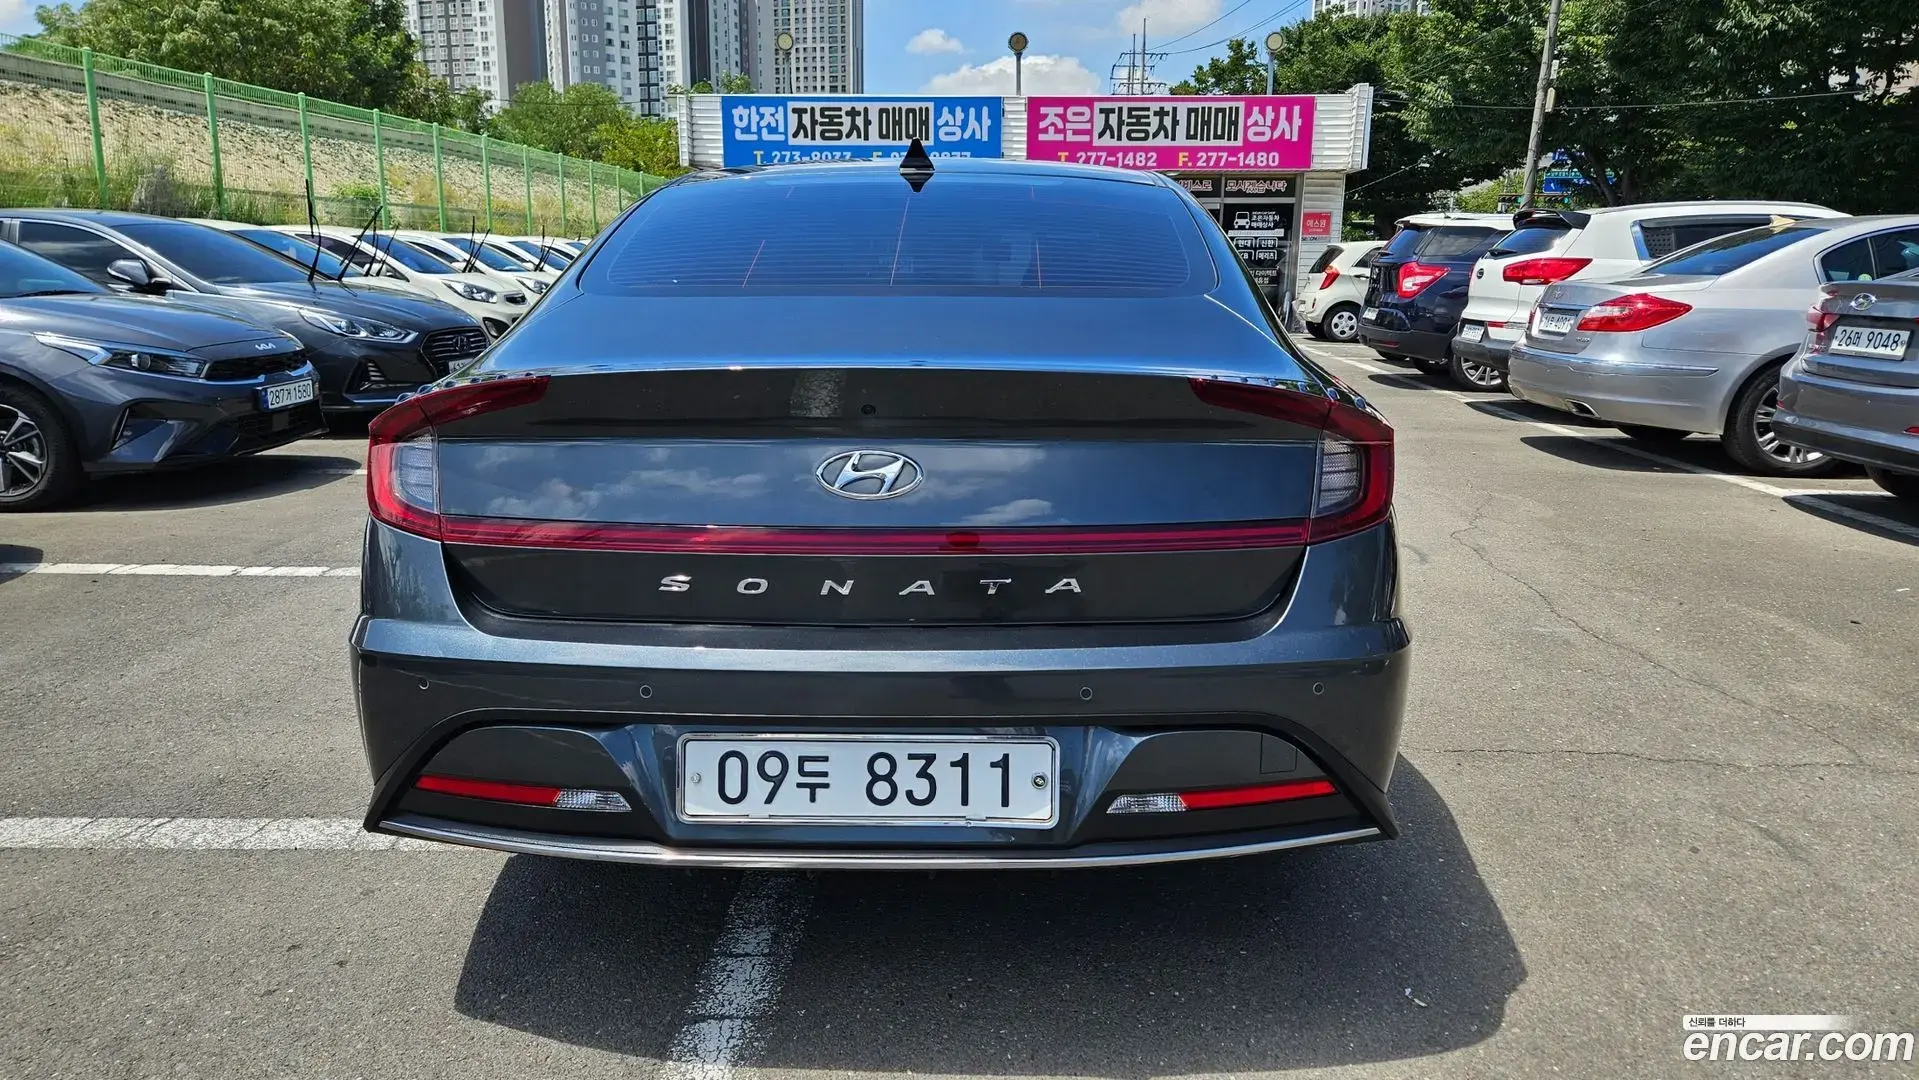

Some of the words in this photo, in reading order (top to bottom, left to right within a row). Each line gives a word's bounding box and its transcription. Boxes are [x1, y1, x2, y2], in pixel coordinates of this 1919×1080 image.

[731, 105, 786, 141] 한전
[791, 106, 872, 141] 자동차
[878, 106, 930, 141] 매매
[937, 105, 991, 142] 상사
[1038, 105, 1092, 142] 조은
[1098, 106, 1179, 142] 자동차
[1185, 106, 1239, 142] 매매
[1246, 105, 1302, 142] 상사
[1076, 151, 1158, 167] 277-1482
[1178, 152, 1192, 167] F.
[1197, 152, 1279, 167] 277-1480
[1225, 179, 1288, 193] 모시겠습니다
[1865, 331, 1901, 351] 9048
[293, 383, 311, 401] 1580
[658, 575, 1082, 596] SONATA
[717, 749, 831, 805] 09두
[865, 751, 1011, 807] 8311
